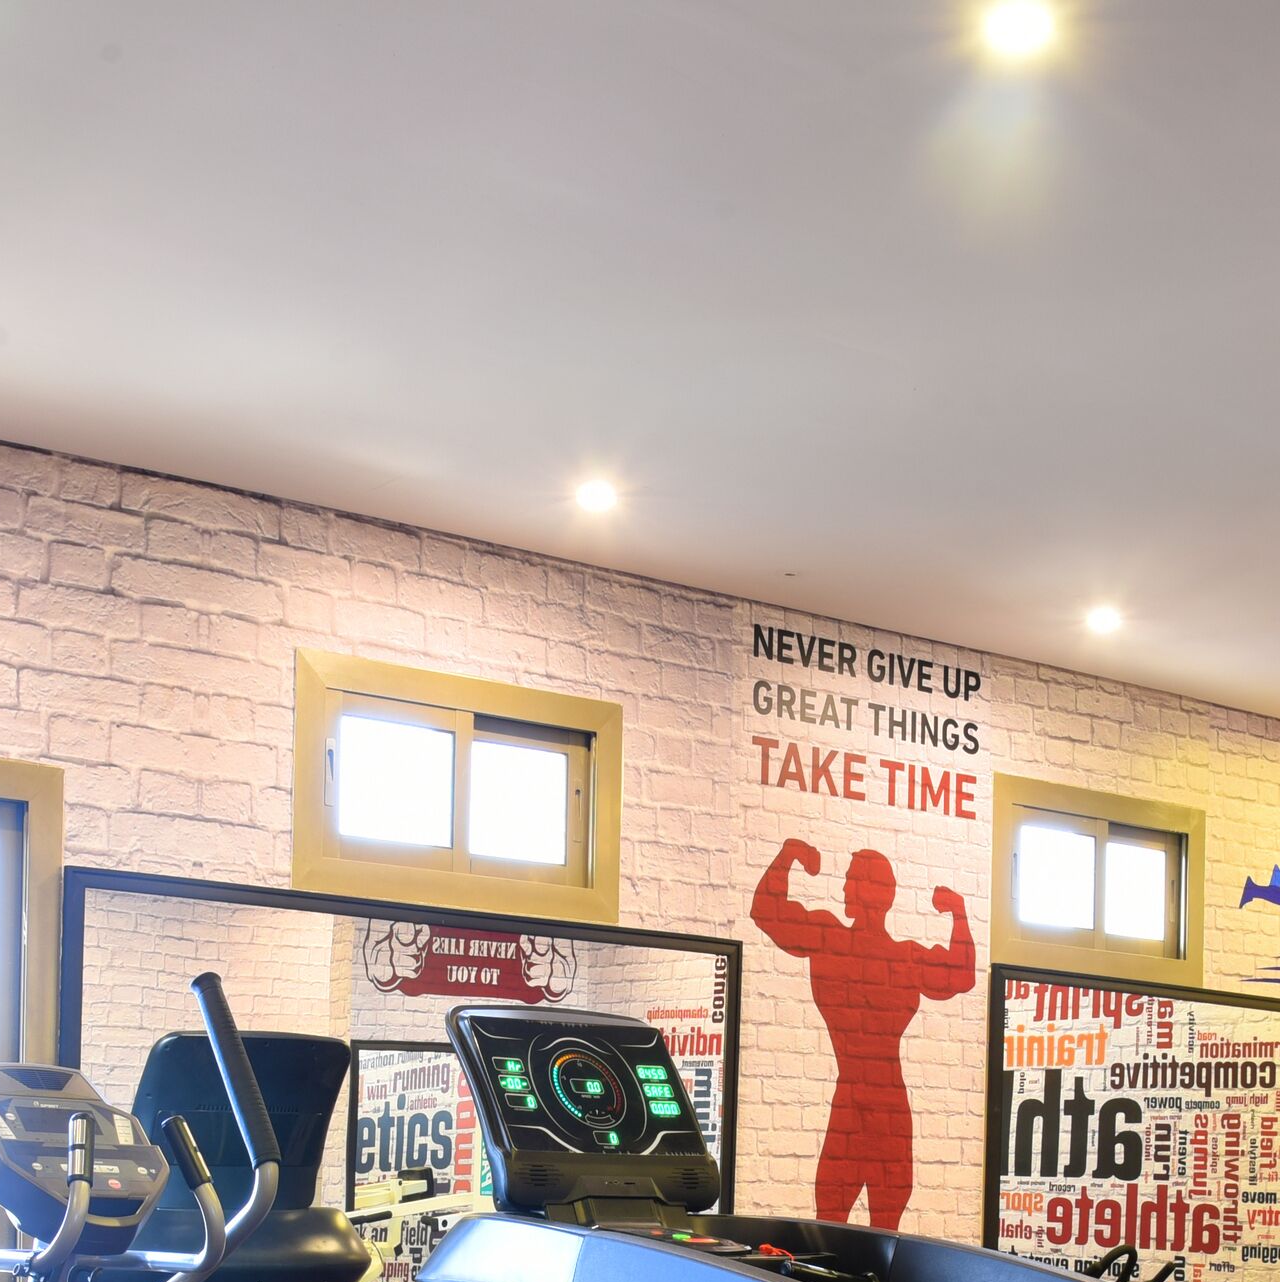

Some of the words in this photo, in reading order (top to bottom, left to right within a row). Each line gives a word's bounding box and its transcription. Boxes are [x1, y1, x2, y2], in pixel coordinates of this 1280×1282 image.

[753, 624, 857, 677] NEVER
[867, 650, 933, 694] GIVE
[942, 666, 981, 701] UP
[753, 680, 858, 731] GREAT
[868, 703, 979, 755] THINGS
[752, 736, 866, 801] TAKE
[880, 758, 977, 820] TIME
[367, 1079, 388, 1101] win
[393, 1058, 451, 1094] running
[643, 1084, 672, 1098] SAFE
